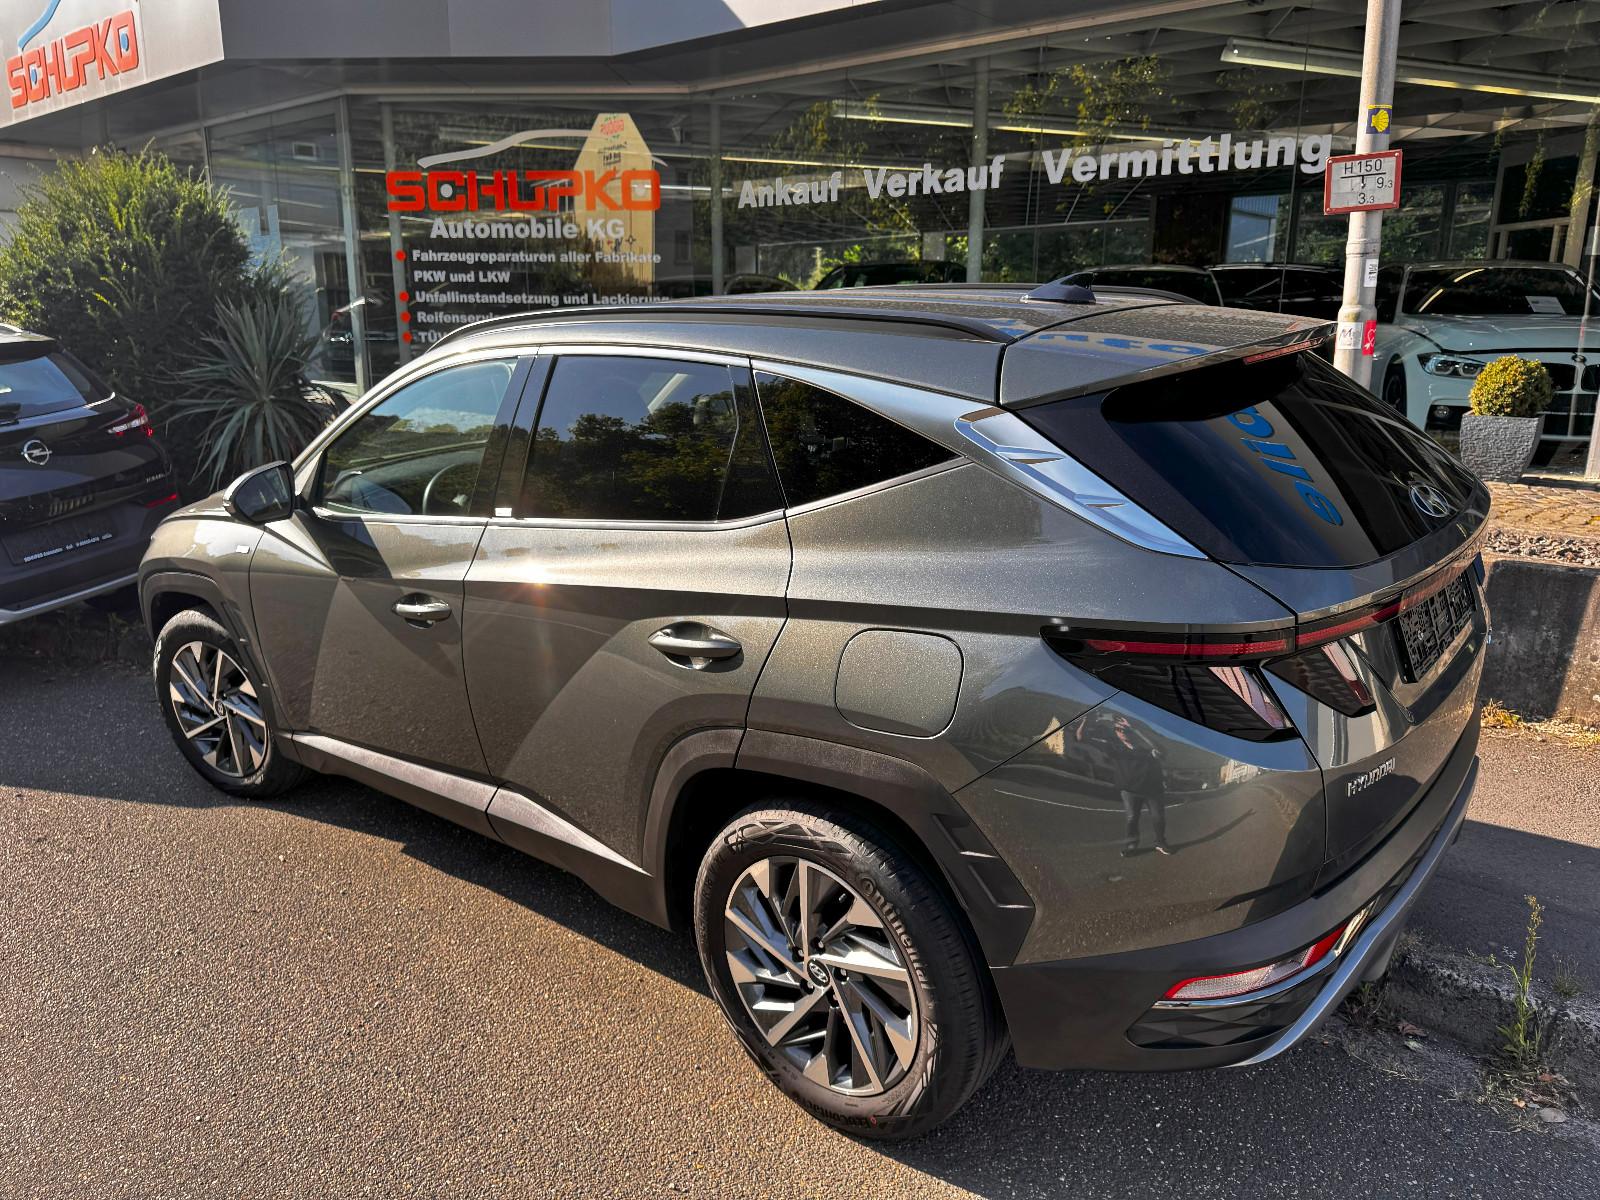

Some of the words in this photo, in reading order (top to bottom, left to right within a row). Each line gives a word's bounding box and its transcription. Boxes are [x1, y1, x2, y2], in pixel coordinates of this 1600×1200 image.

[738, 171, 842, 209] Ankauf
[863, 155, 1006, 199] Verkauf
[1041, 133, 1333, 185] Vermittlung
[430, 217, 578, 239] Automobile
[586, 218, 625, 239] KG
[412, 249, 556, 264] Fahrzeugreparaturen
[560, 251, 591, 263] aller
[595, 251, 662, 263] Fabrikate
[413, 270, 447, 283] PKW
[449, 271, 476, 283] und
[479, 271, 511, 284] LKW
[415, 290, 560, 307] Unfallinstandsetzung
[563, 293, 589, 305] und
[1347, 757, 1396, 798] HYUNDAI
